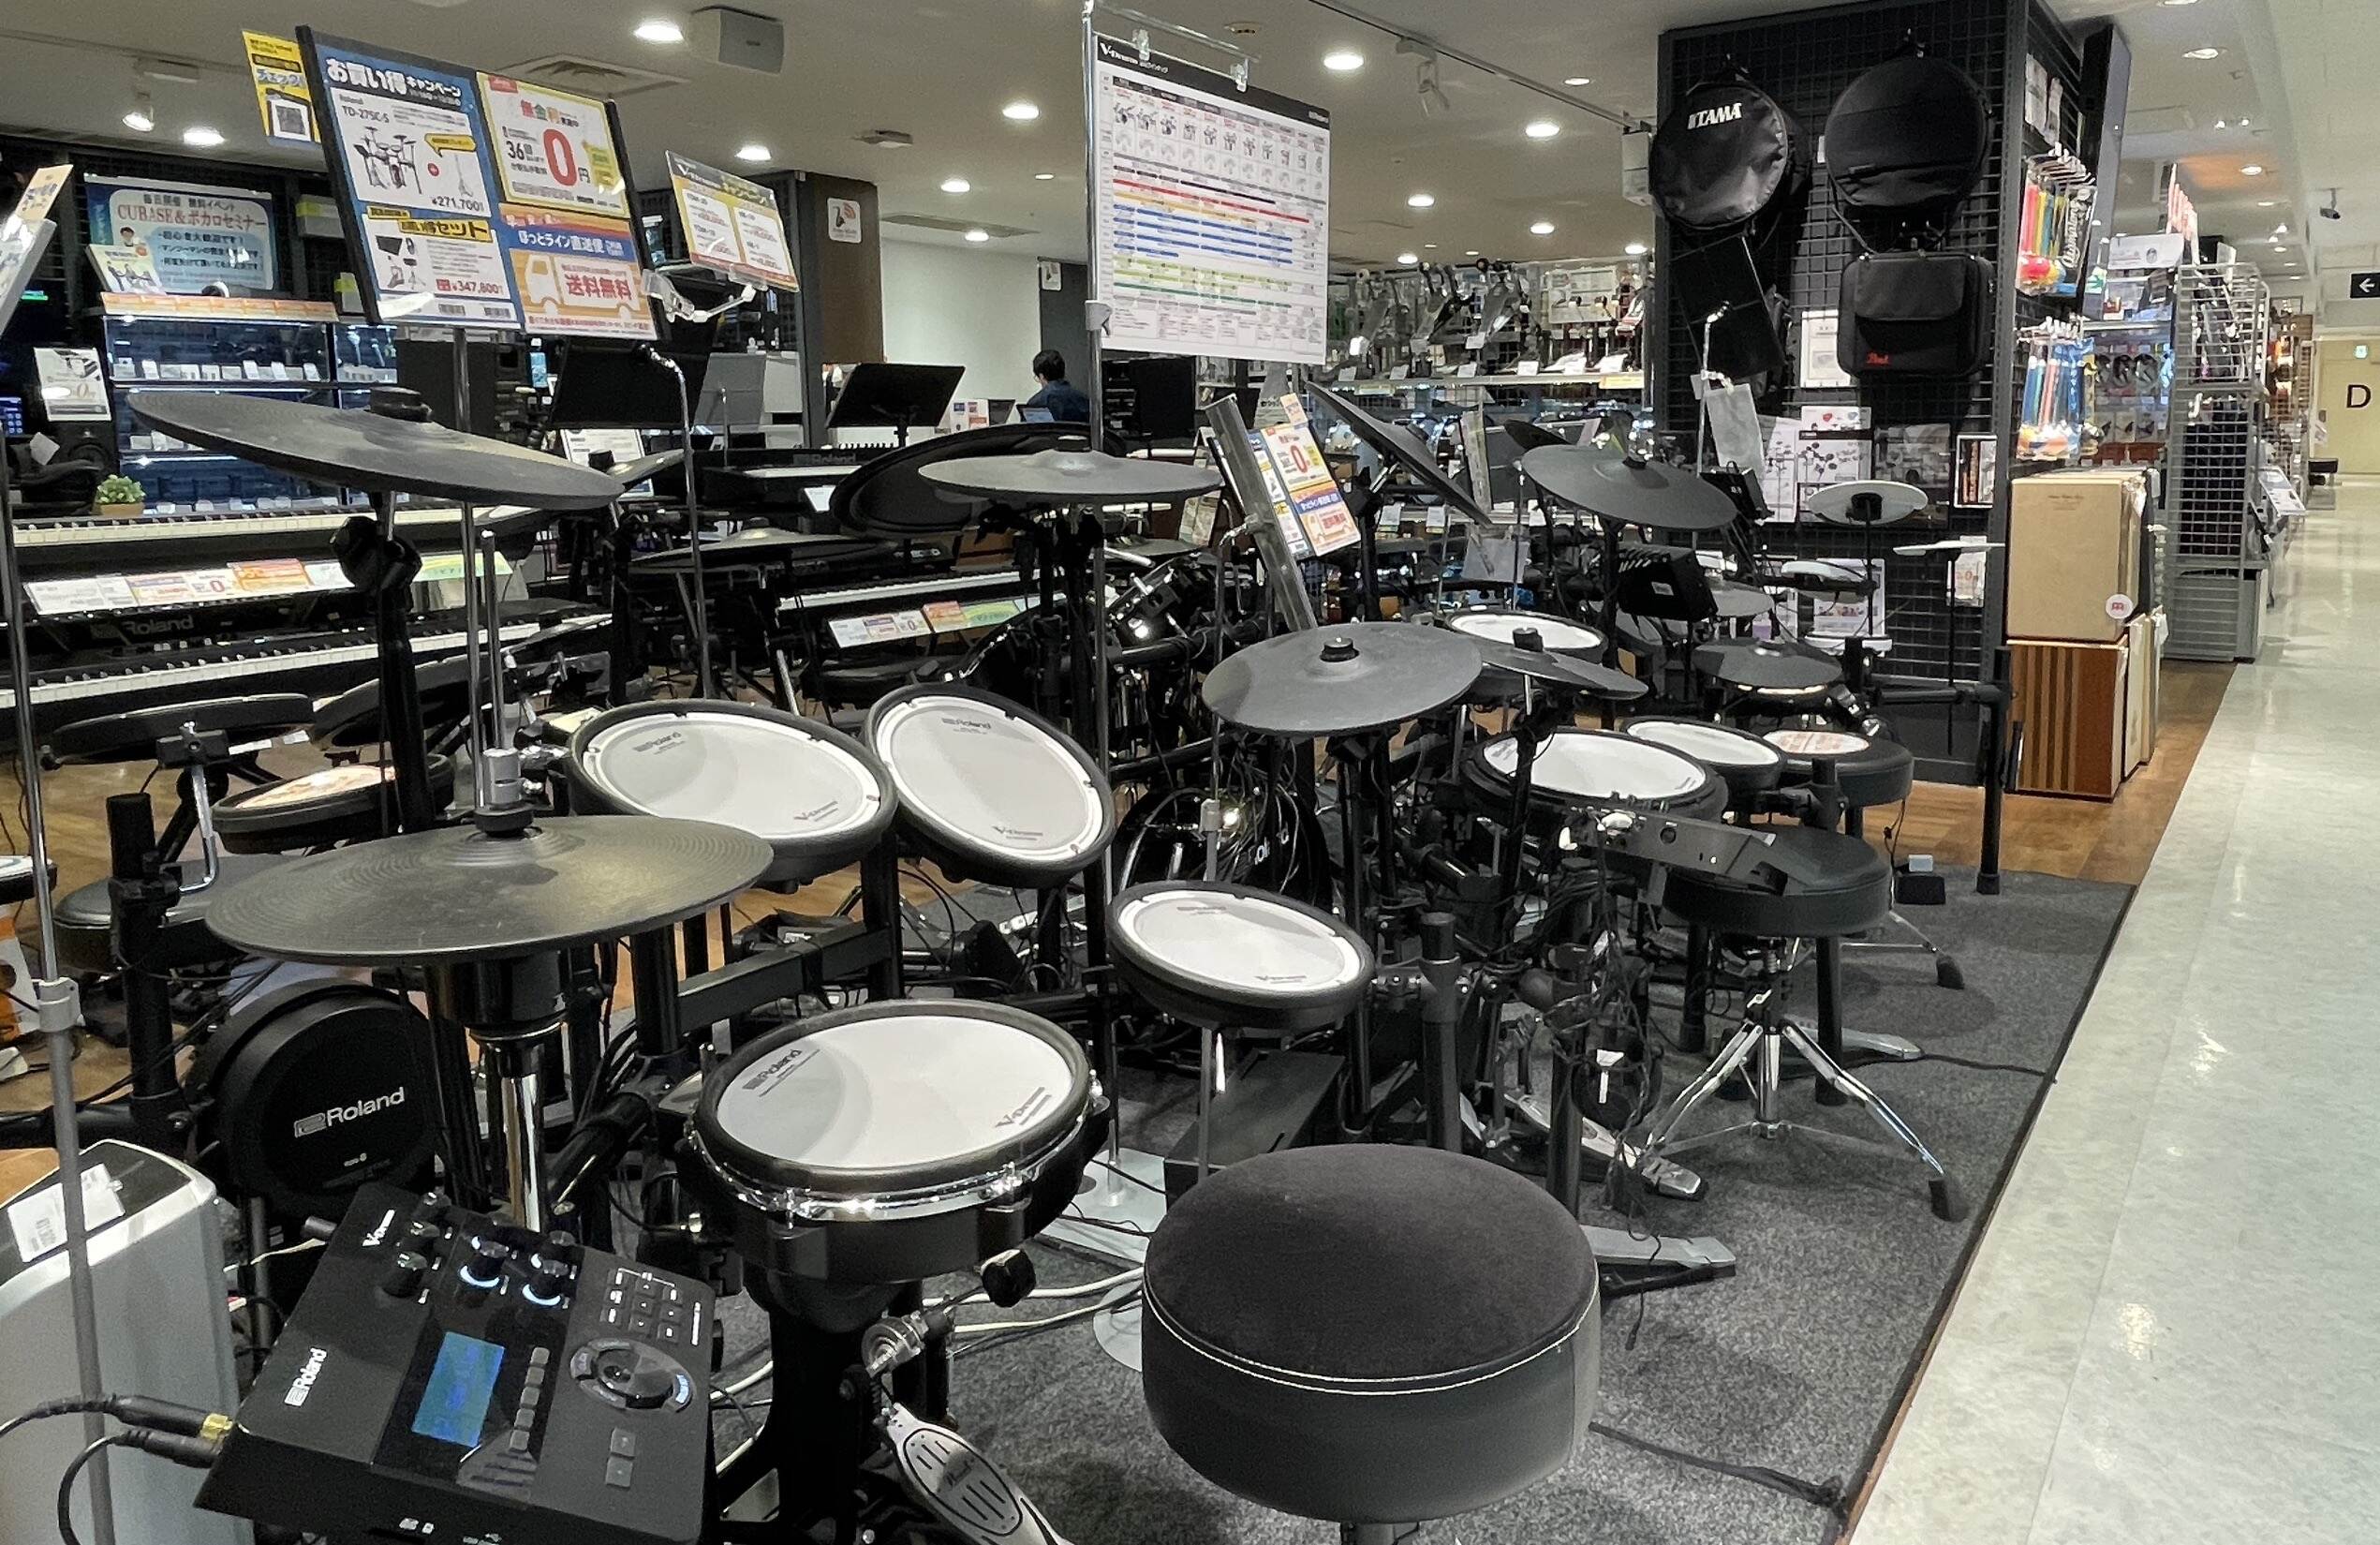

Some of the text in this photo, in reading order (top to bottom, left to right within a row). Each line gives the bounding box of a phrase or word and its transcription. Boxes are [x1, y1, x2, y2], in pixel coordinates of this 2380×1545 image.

[1695, 102, 1743, 128] TAMA
[564, 270, 632, 301] 送料無料
[2346, 384, 2372, 409] D
[122, 614, 195, 635] Roland
[326, 1086, 406, 1127] Roland
[292, 1346, 328, 1388] Roland
